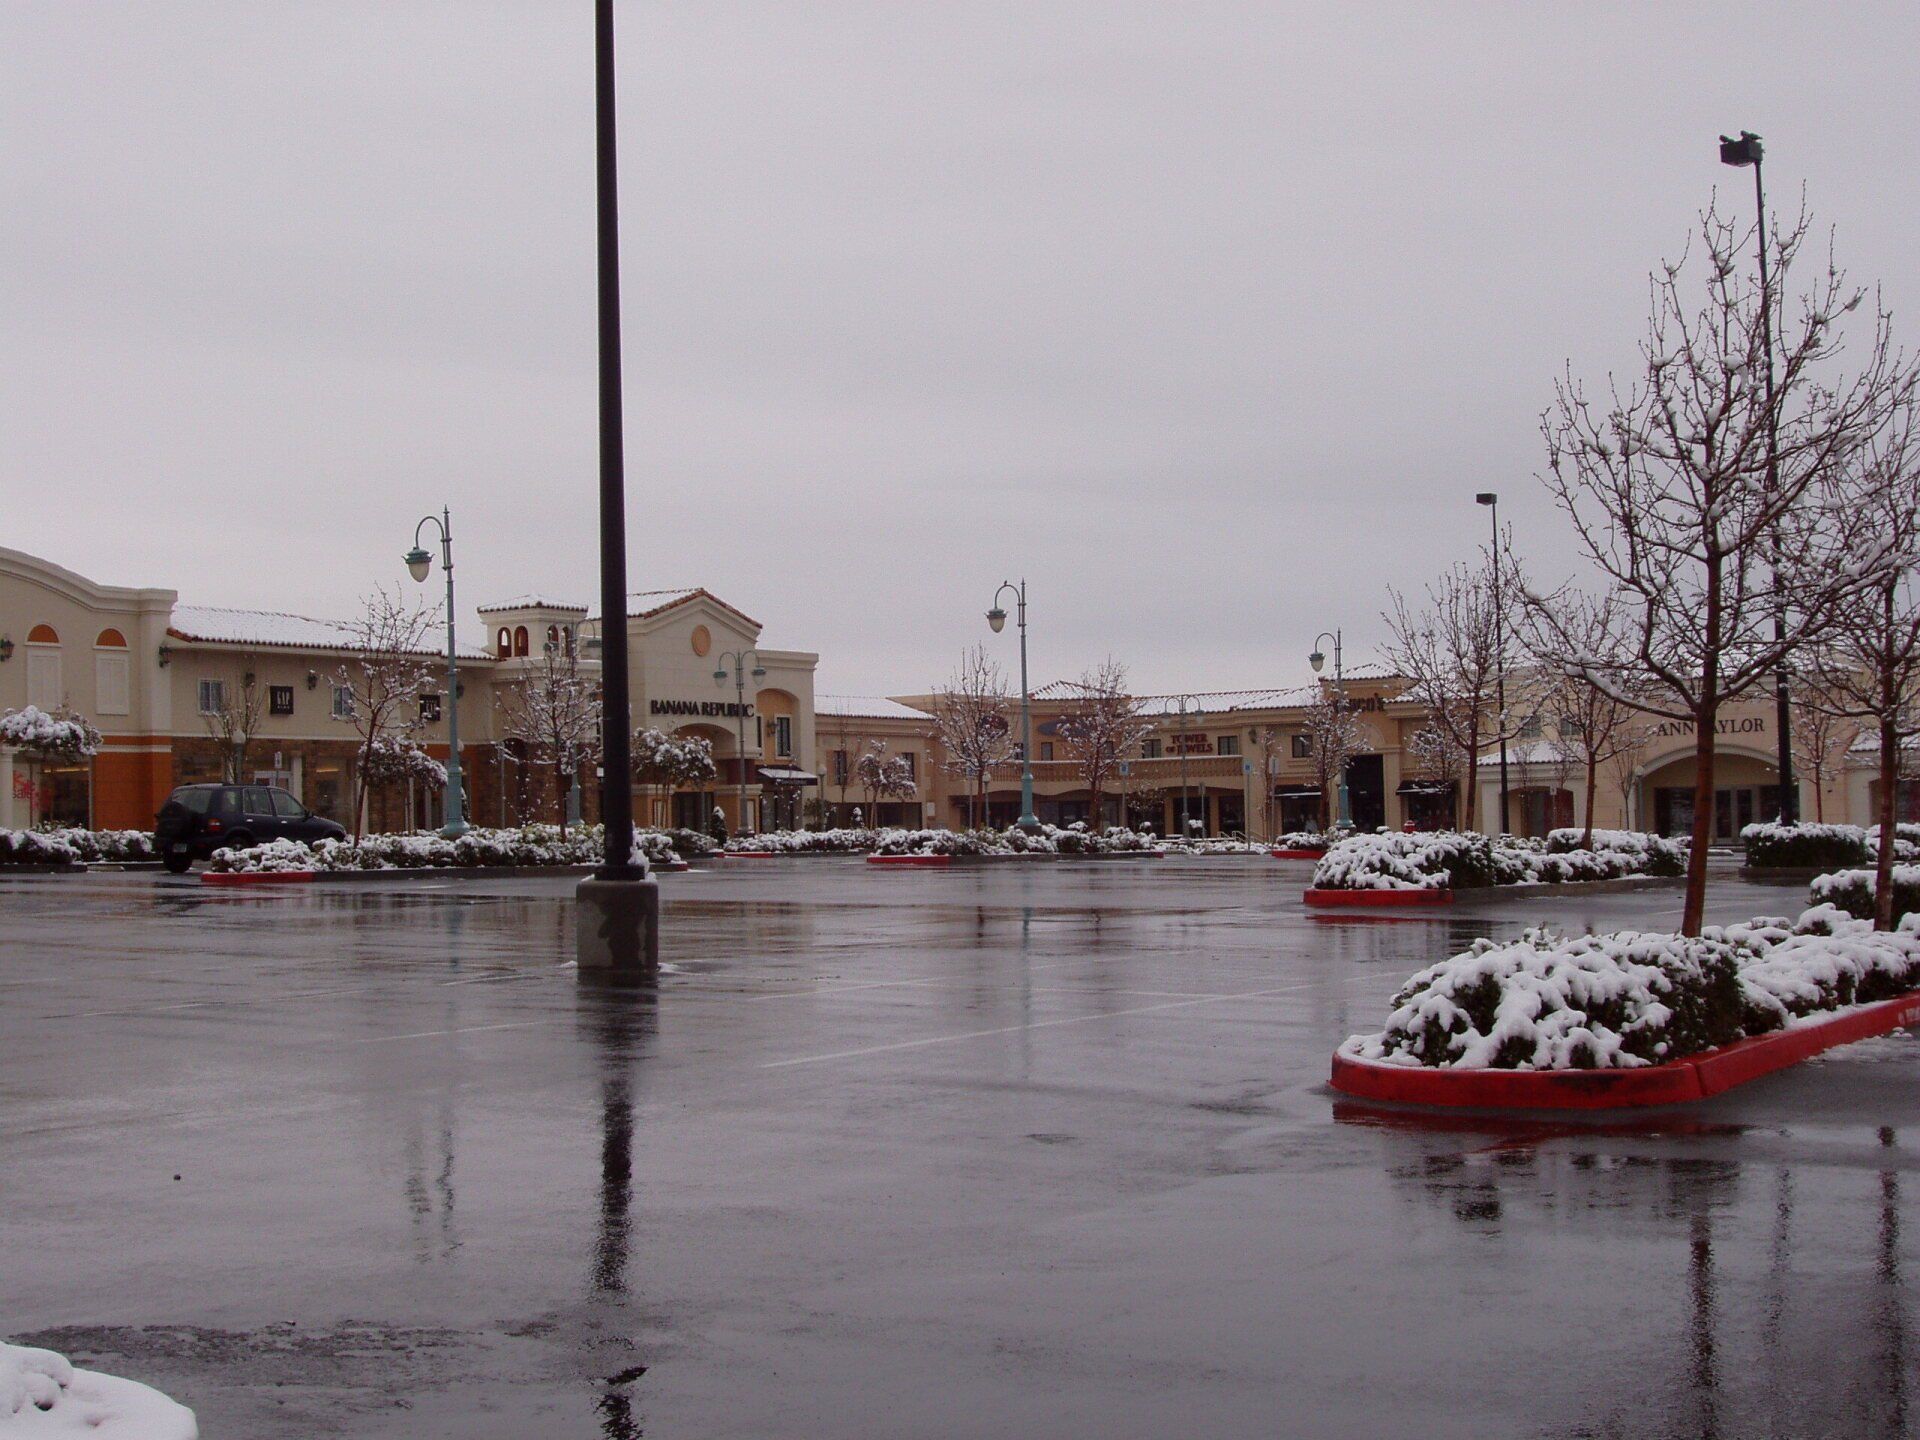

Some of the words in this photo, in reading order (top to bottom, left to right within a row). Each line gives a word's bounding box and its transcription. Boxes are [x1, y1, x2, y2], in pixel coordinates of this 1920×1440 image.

[276, 691, 290, 705] GAP
[651, 700, 700, 716] BANANA
[1656, 721, 1694, 737] ANN
[1711, 718, 1765, 734] YLOR
